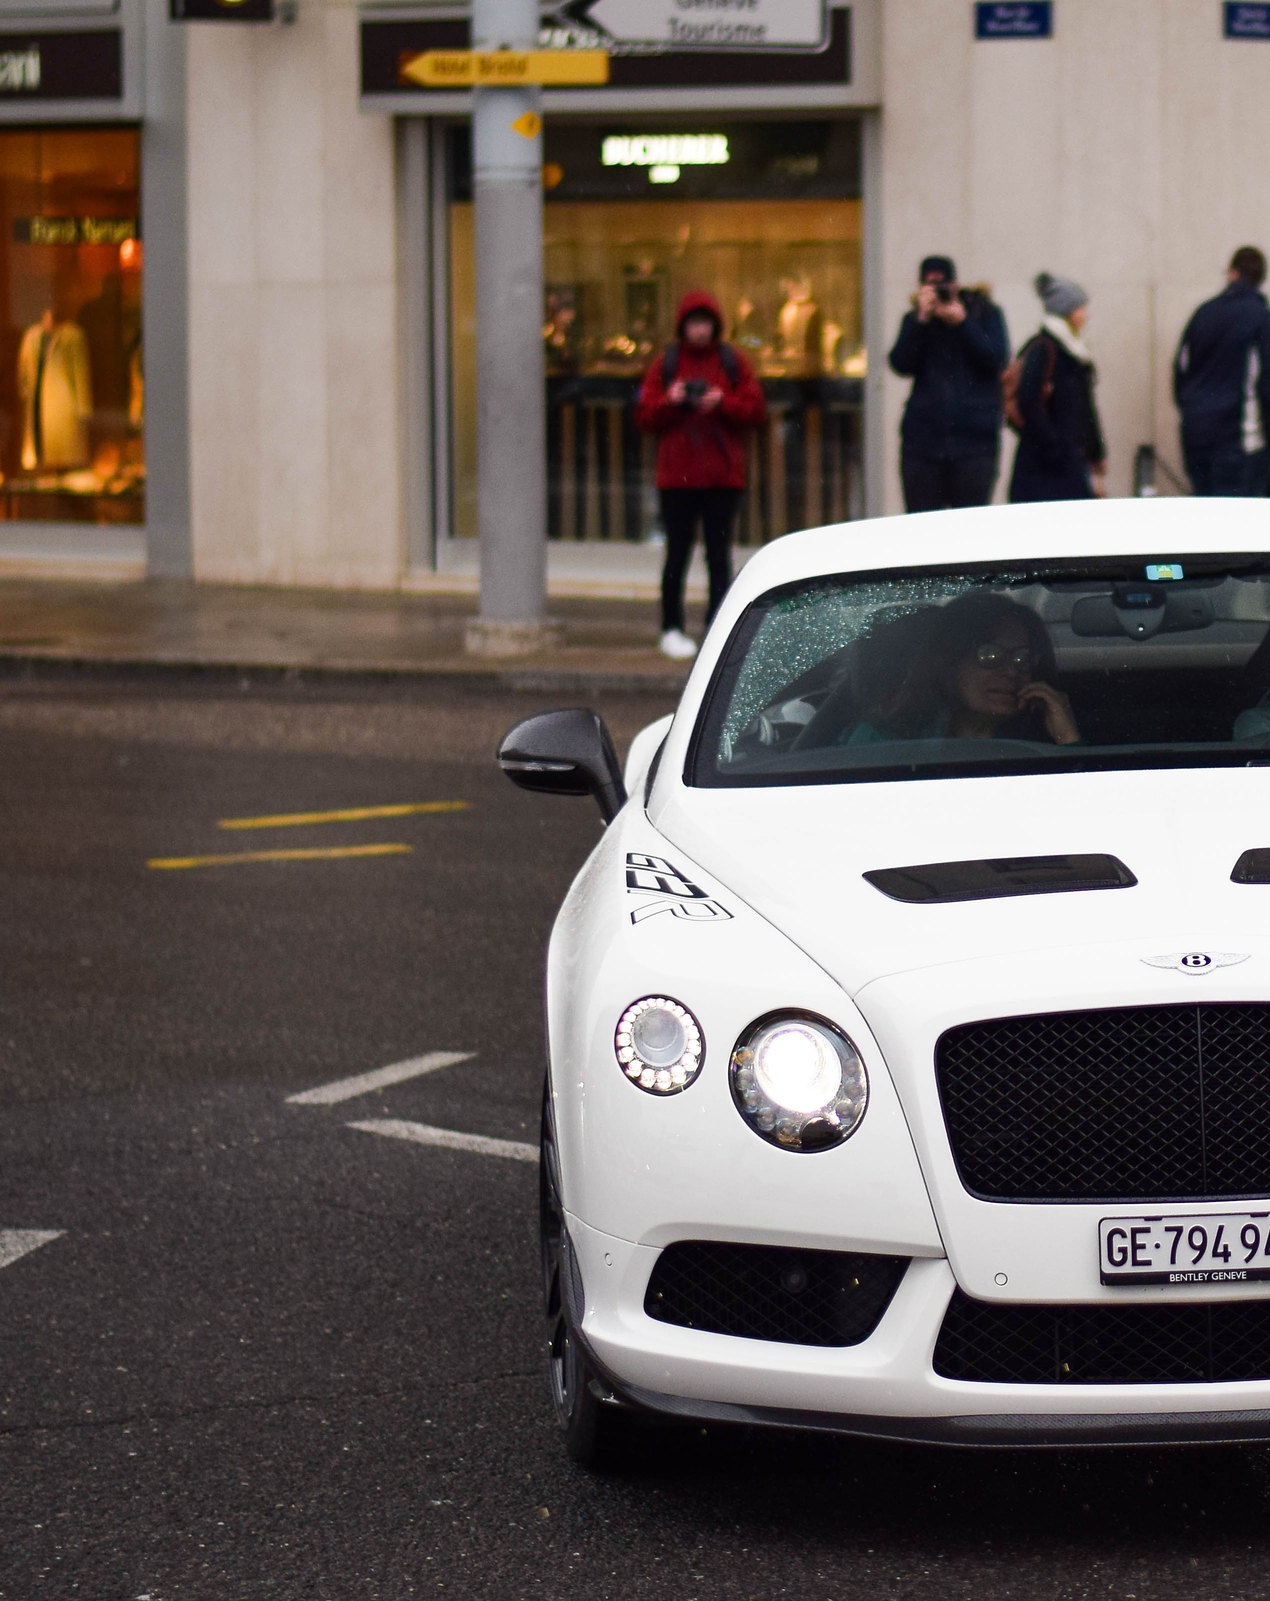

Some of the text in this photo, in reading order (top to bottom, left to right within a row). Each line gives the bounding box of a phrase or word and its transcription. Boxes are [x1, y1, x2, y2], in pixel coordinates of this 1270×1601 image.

[668, 17, 767, 41] Tourisme
[1169, 1270, 1247, 1283] BENTLEY GENEVE
